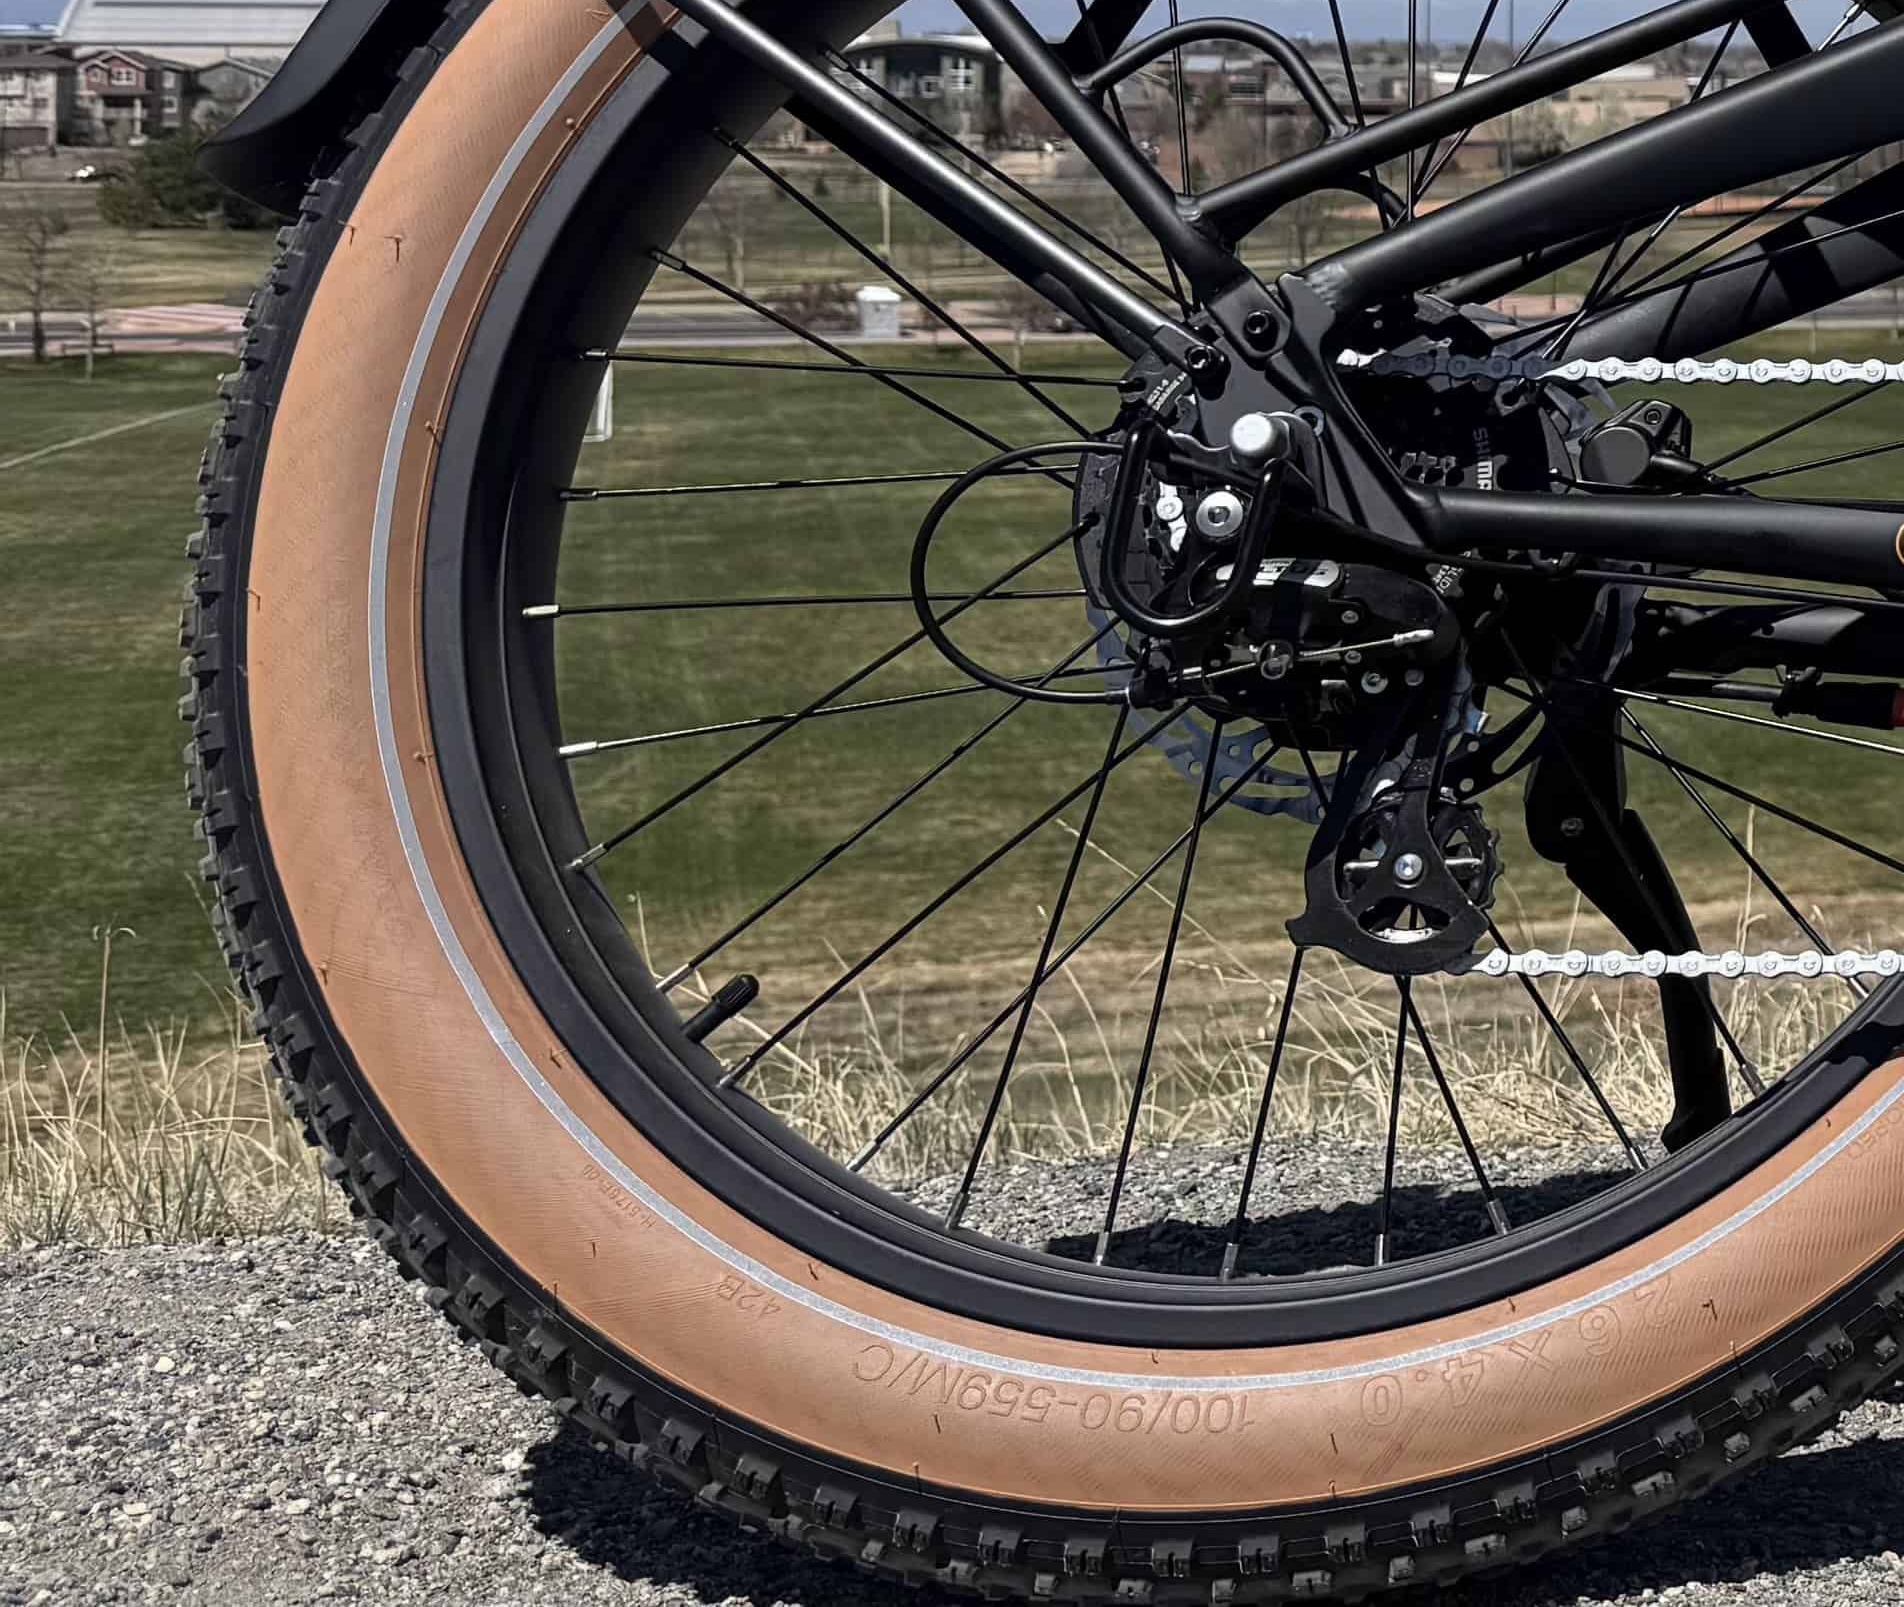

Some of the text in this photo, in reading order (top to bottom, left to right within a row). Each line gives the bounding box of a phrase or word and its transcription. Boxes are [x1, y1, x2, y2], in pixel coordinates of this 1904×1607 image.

[1577, 1273, 1676, 1357] 26
[851, 1342, 1256, 1435] 100/90-559M/C
[1360, 1348, 1495, 1427] 4.0
